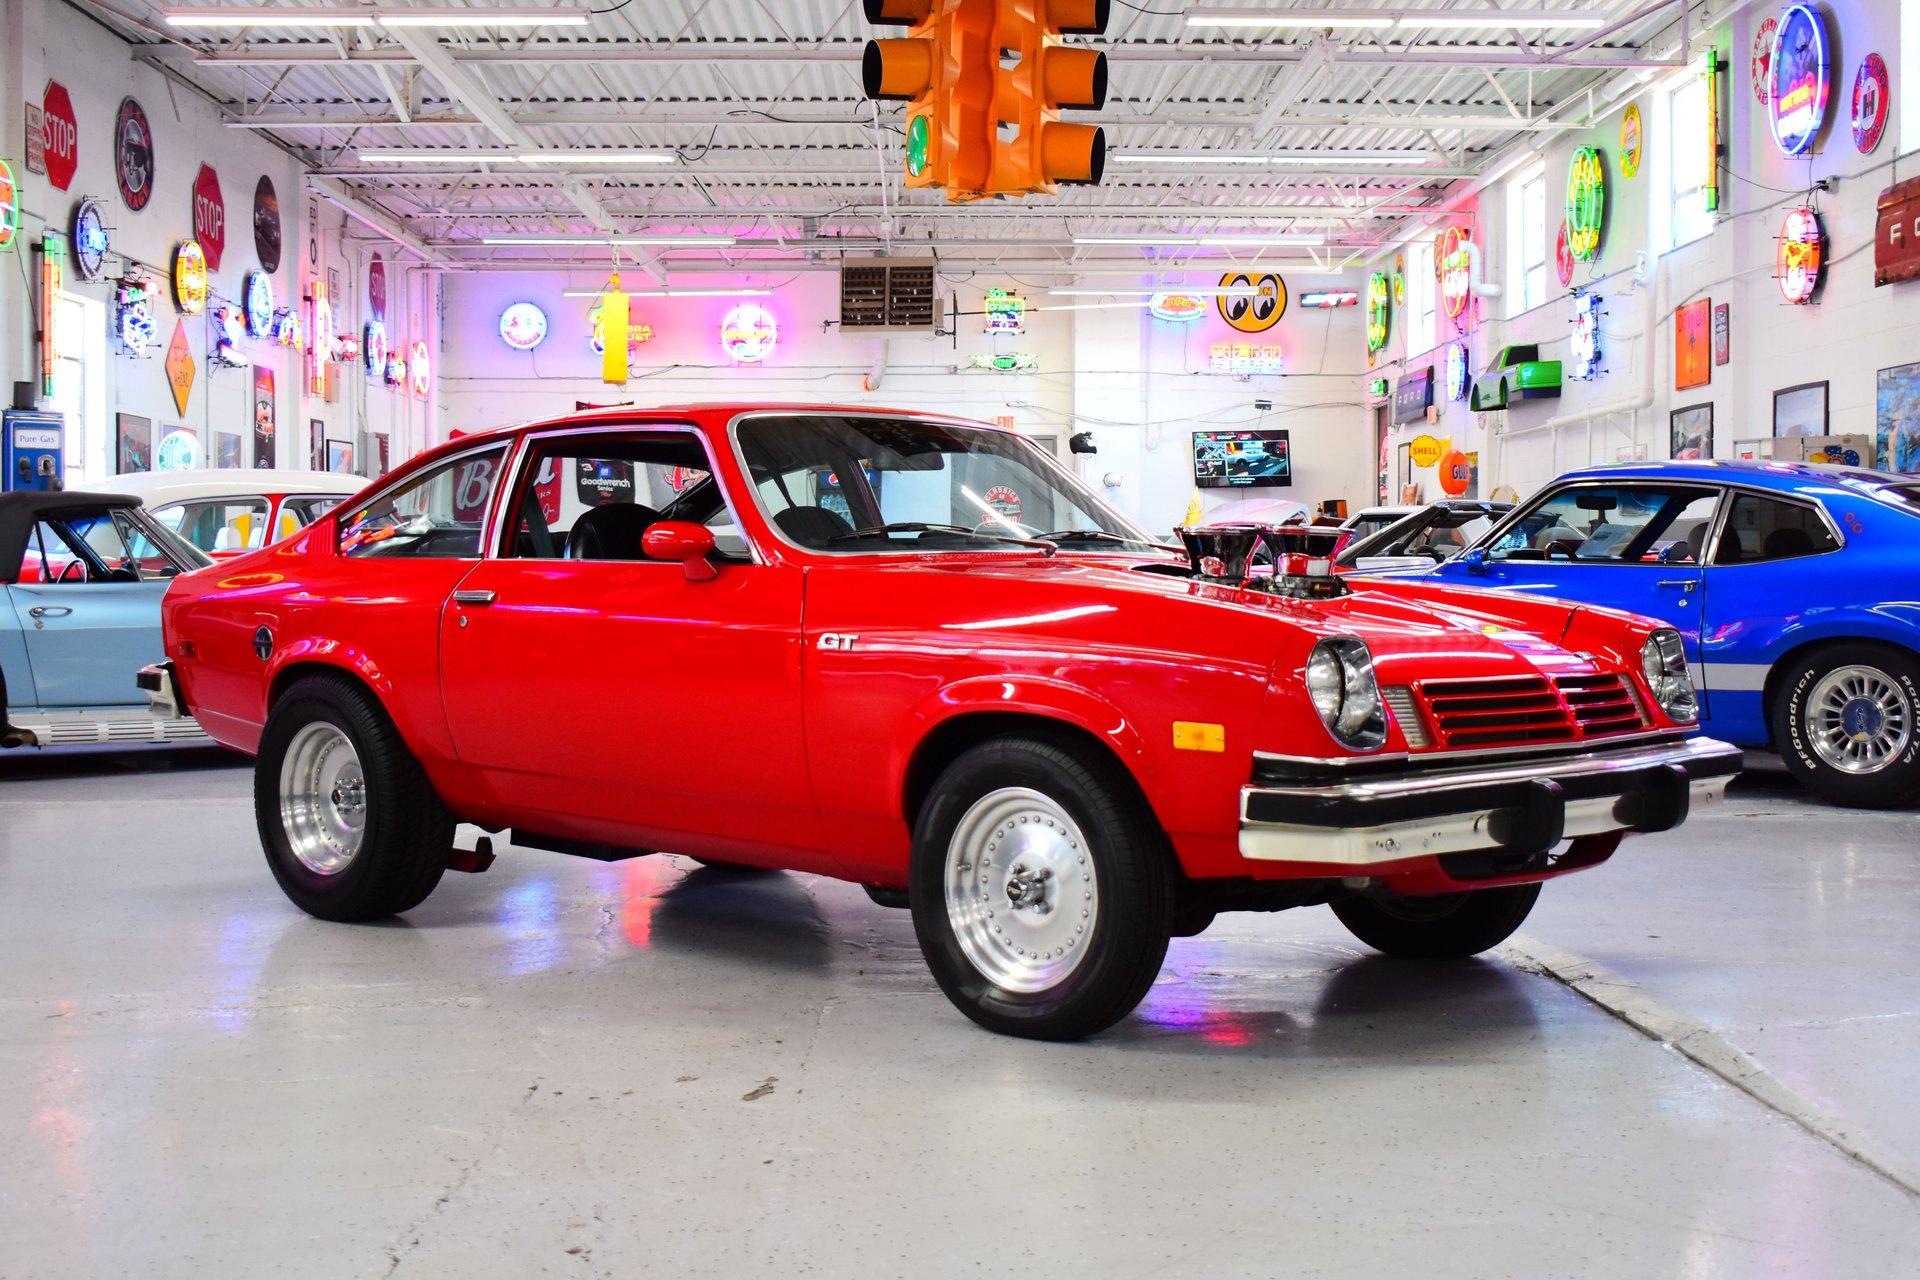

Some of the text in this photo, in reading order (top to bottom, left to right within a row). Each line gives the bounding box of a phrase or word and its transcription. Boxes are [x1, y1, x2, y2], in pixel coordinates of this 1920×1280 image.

[44, 111, 76, 160] STOP
[196, 194, 223, 241] STOP
[371, 271, 385, 301] STOP
[1397, 388, 1421, 405] FORD
[997, 416, 1015, 430] EXIT
[19, 434, 55, 443] Pure Gas
[1413, 447, 1438, 455] SHELL
[581, 463, 593, 471] 3
[581, 477, 630, 488] Goodwrench
[816, 632, 860, 651] GT
[1788, 669, 1817, 770] BFGoodrich
